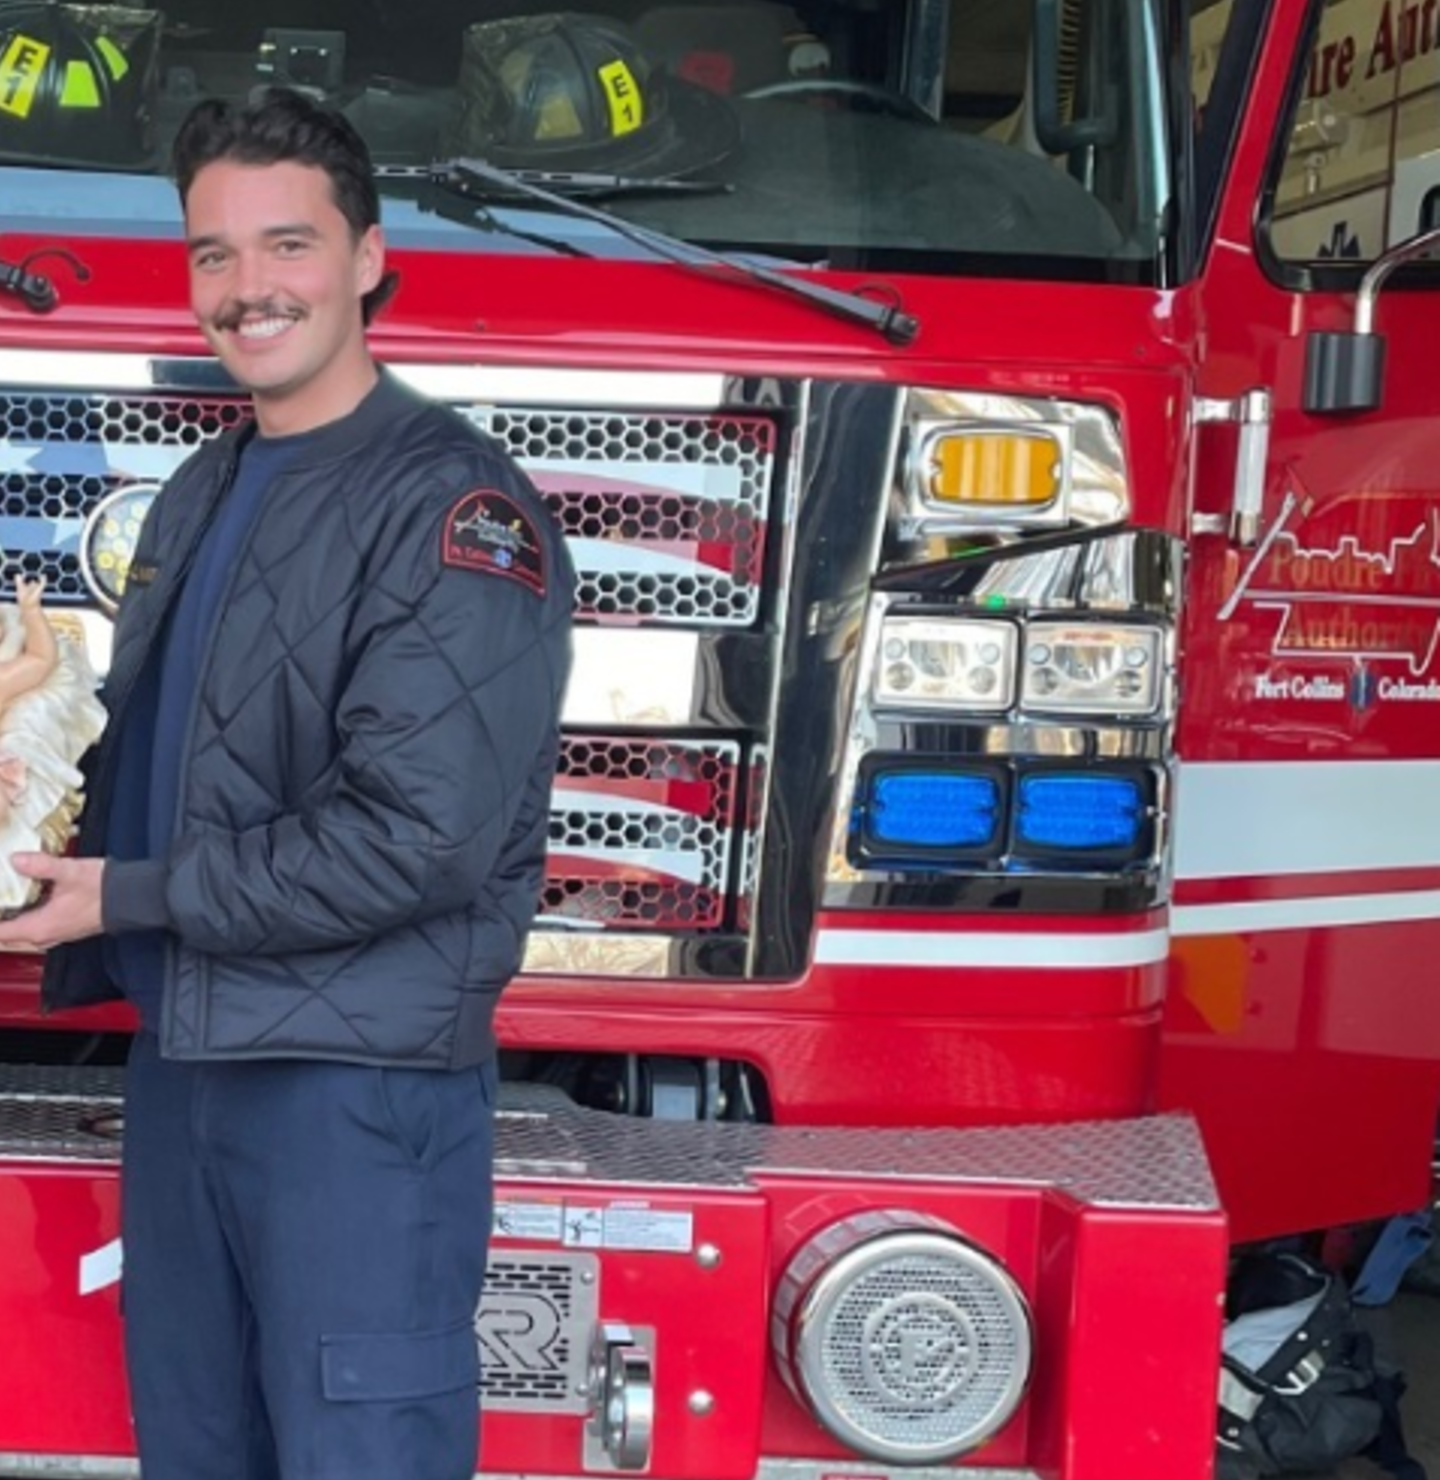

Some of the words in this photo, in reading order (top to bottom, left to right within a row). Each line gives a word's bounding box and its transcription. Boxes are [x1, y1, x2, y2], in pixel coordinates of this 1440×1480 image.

[13, 44, 39, 76] E
[1308, 36, 1355, 98] ire
[612, 73, 630, 98] E
[1268, 549, 1384, 590] Poudre
[1255, 674, 1289, 699] Fort
[1291, 675, 1345, 699] Collins
